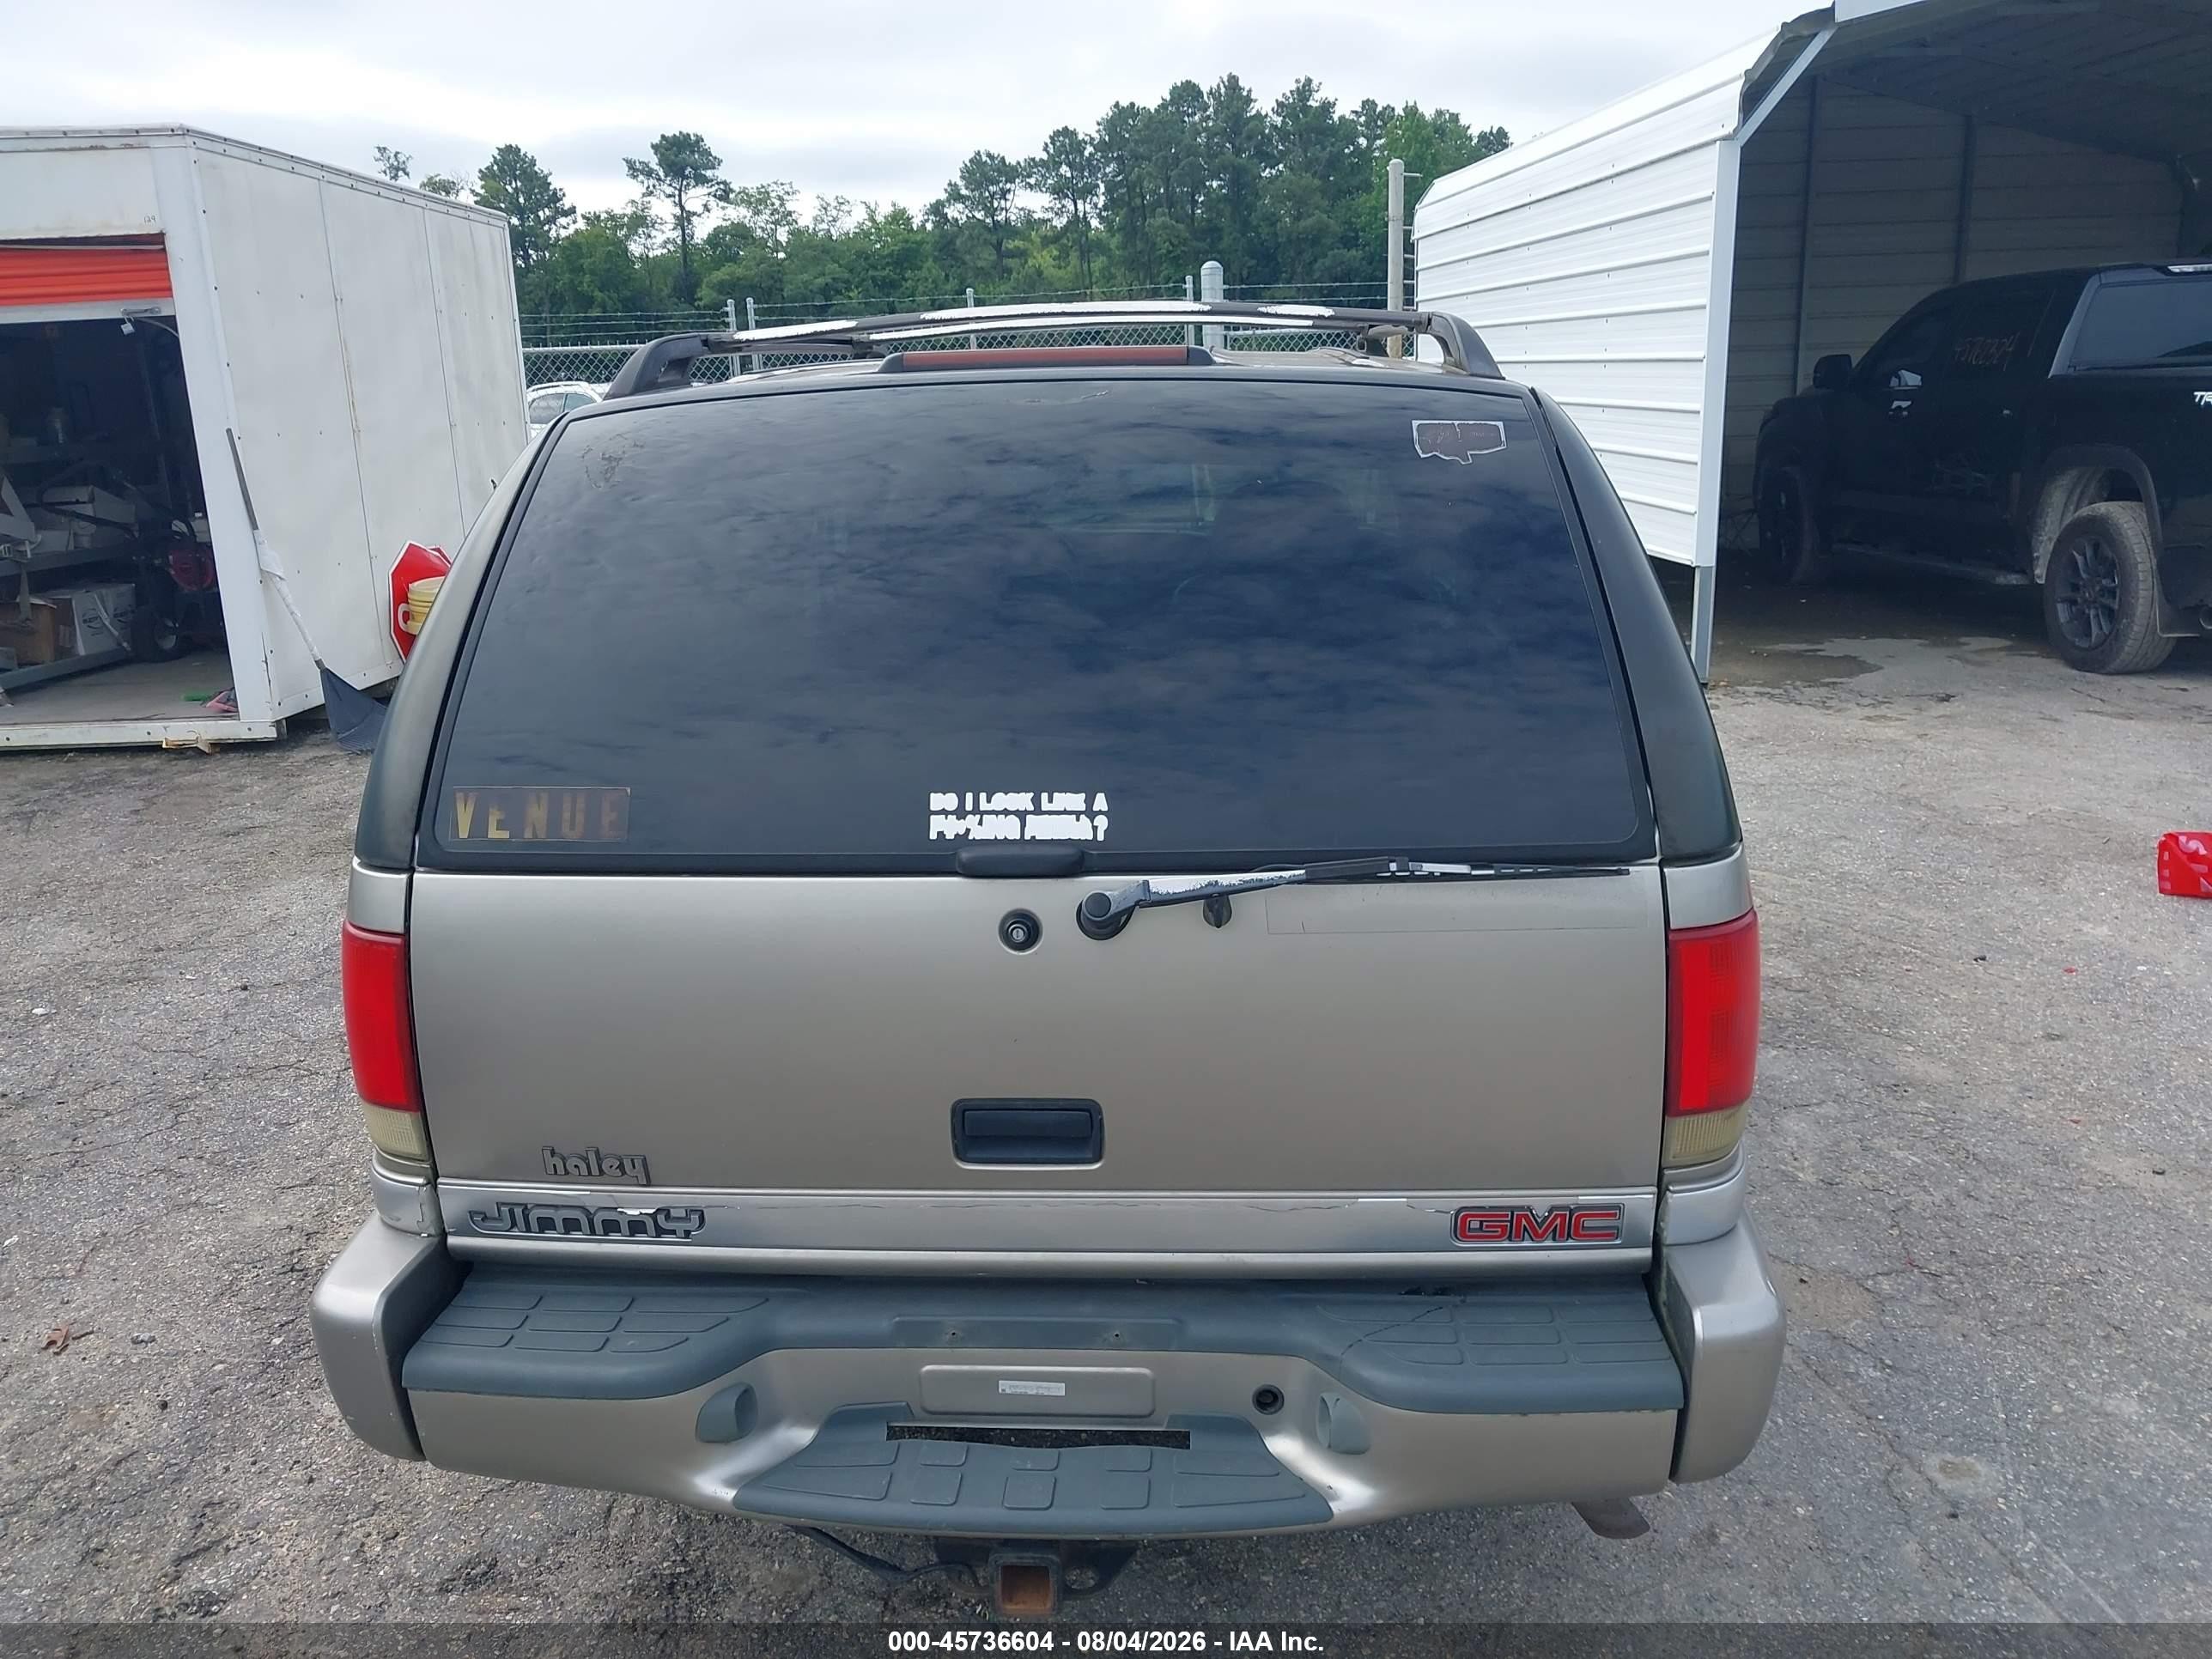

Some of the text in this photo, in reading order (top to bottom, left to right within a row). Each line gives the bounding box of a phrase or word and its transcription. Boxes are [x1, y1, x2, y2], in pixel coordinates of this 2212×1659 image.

[964, 792, 974, 811] I
[979, 792, 1035, 811] LOOK
[1092, 792, 1109, 811] A
[542, 1146, 651, 1186] haley
[1456, 1209, 1620, 1243] GMC
